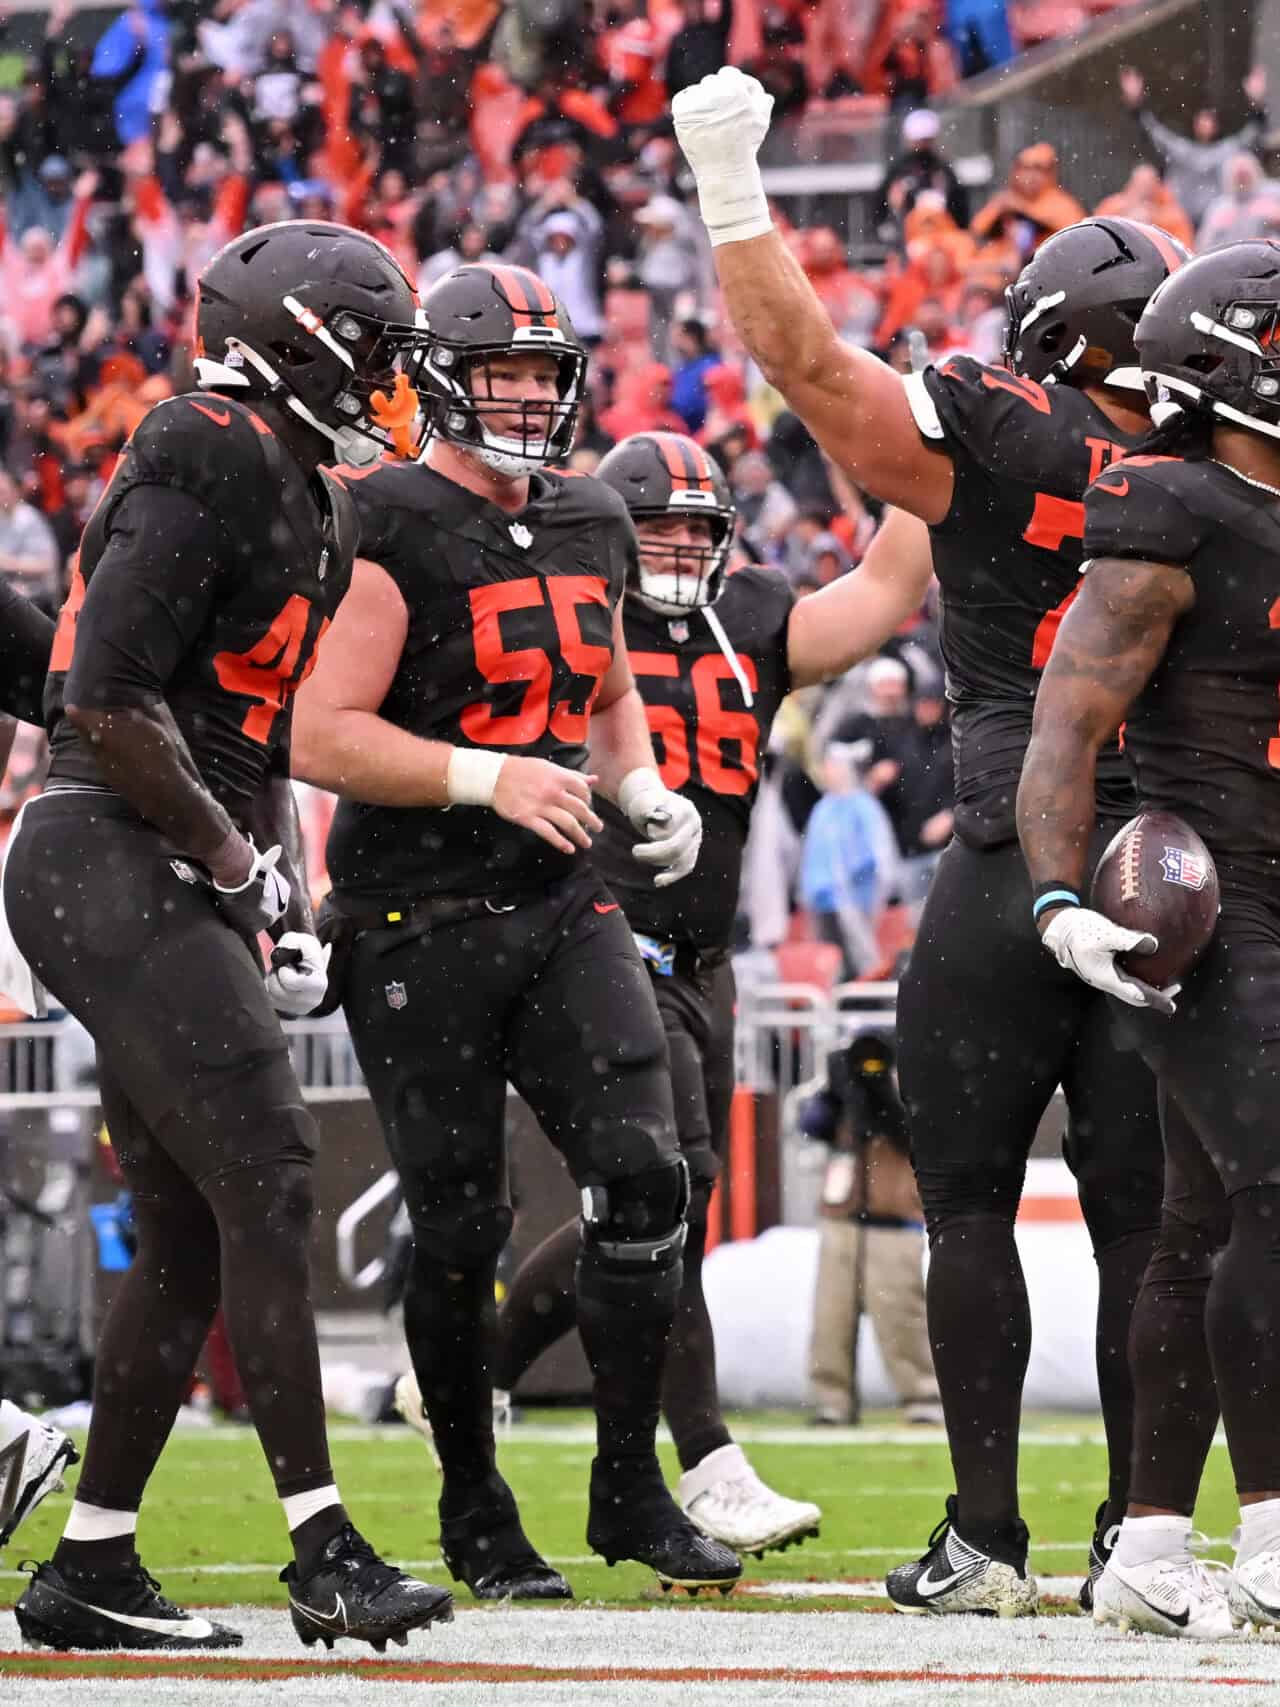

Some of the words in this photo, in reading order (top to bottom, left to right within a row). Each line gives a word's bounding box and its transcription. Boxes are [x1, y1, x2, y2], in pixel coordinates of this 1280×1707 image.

[212, 593, 332, 745] 4
[459, 575, 613, 745] 55
[626, 651, 761, 797] 56
